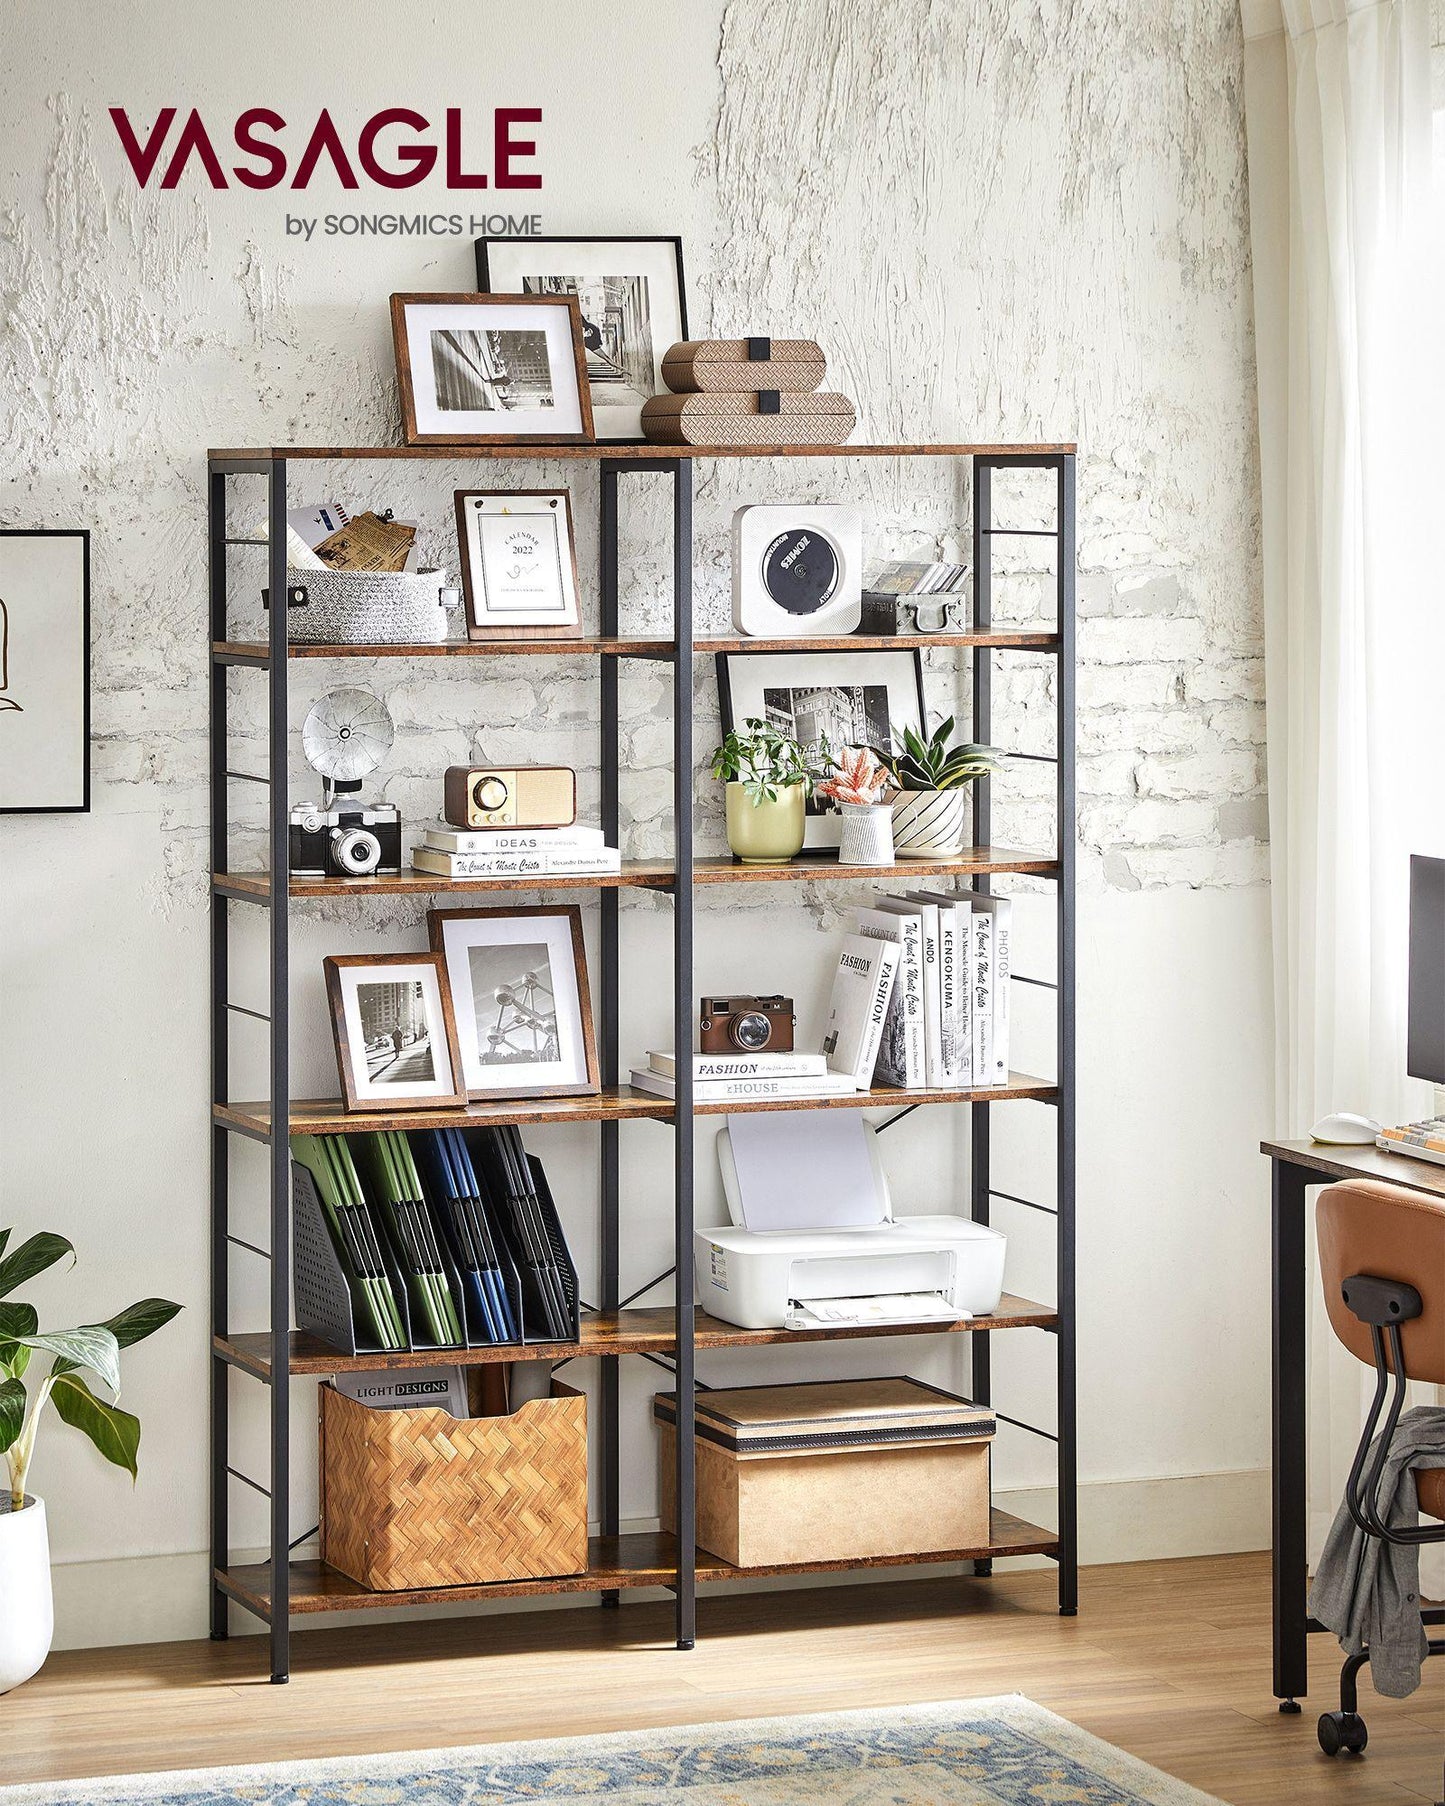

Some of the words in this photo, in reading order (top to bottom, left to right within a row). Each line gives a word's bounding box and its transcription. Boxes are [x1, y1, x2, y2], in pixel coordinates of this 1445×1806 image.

[505, 531, 539, 546] CALENDAR
[512, 545, 533, 554] 2022
[495, 839, 537, 848] IDEAS
[519, 858, 540, 872] Cristo
[905, 922, 918, 935] The
[978, 918, 990, 930] The
[926, 937, 934, 963] ANDO
[998, 930, 1009, 978] PHOTOS
[840, 953, 872, 972] FASHION
[944, 930, 952, 1008] KENGOKUMA
[872, 962, 892, 1024] FASHION
[975, 986, 988, 1008] Cristo
[906, 994, 920, 1016] Cristo
[698, 1064, 758, 1074] FASHION
[734, 1082, 778, 1093] HOUSE
[357, 1386, 394, 1398] LIGHT
[396, 1382, 448, 1394] DESIGNS
